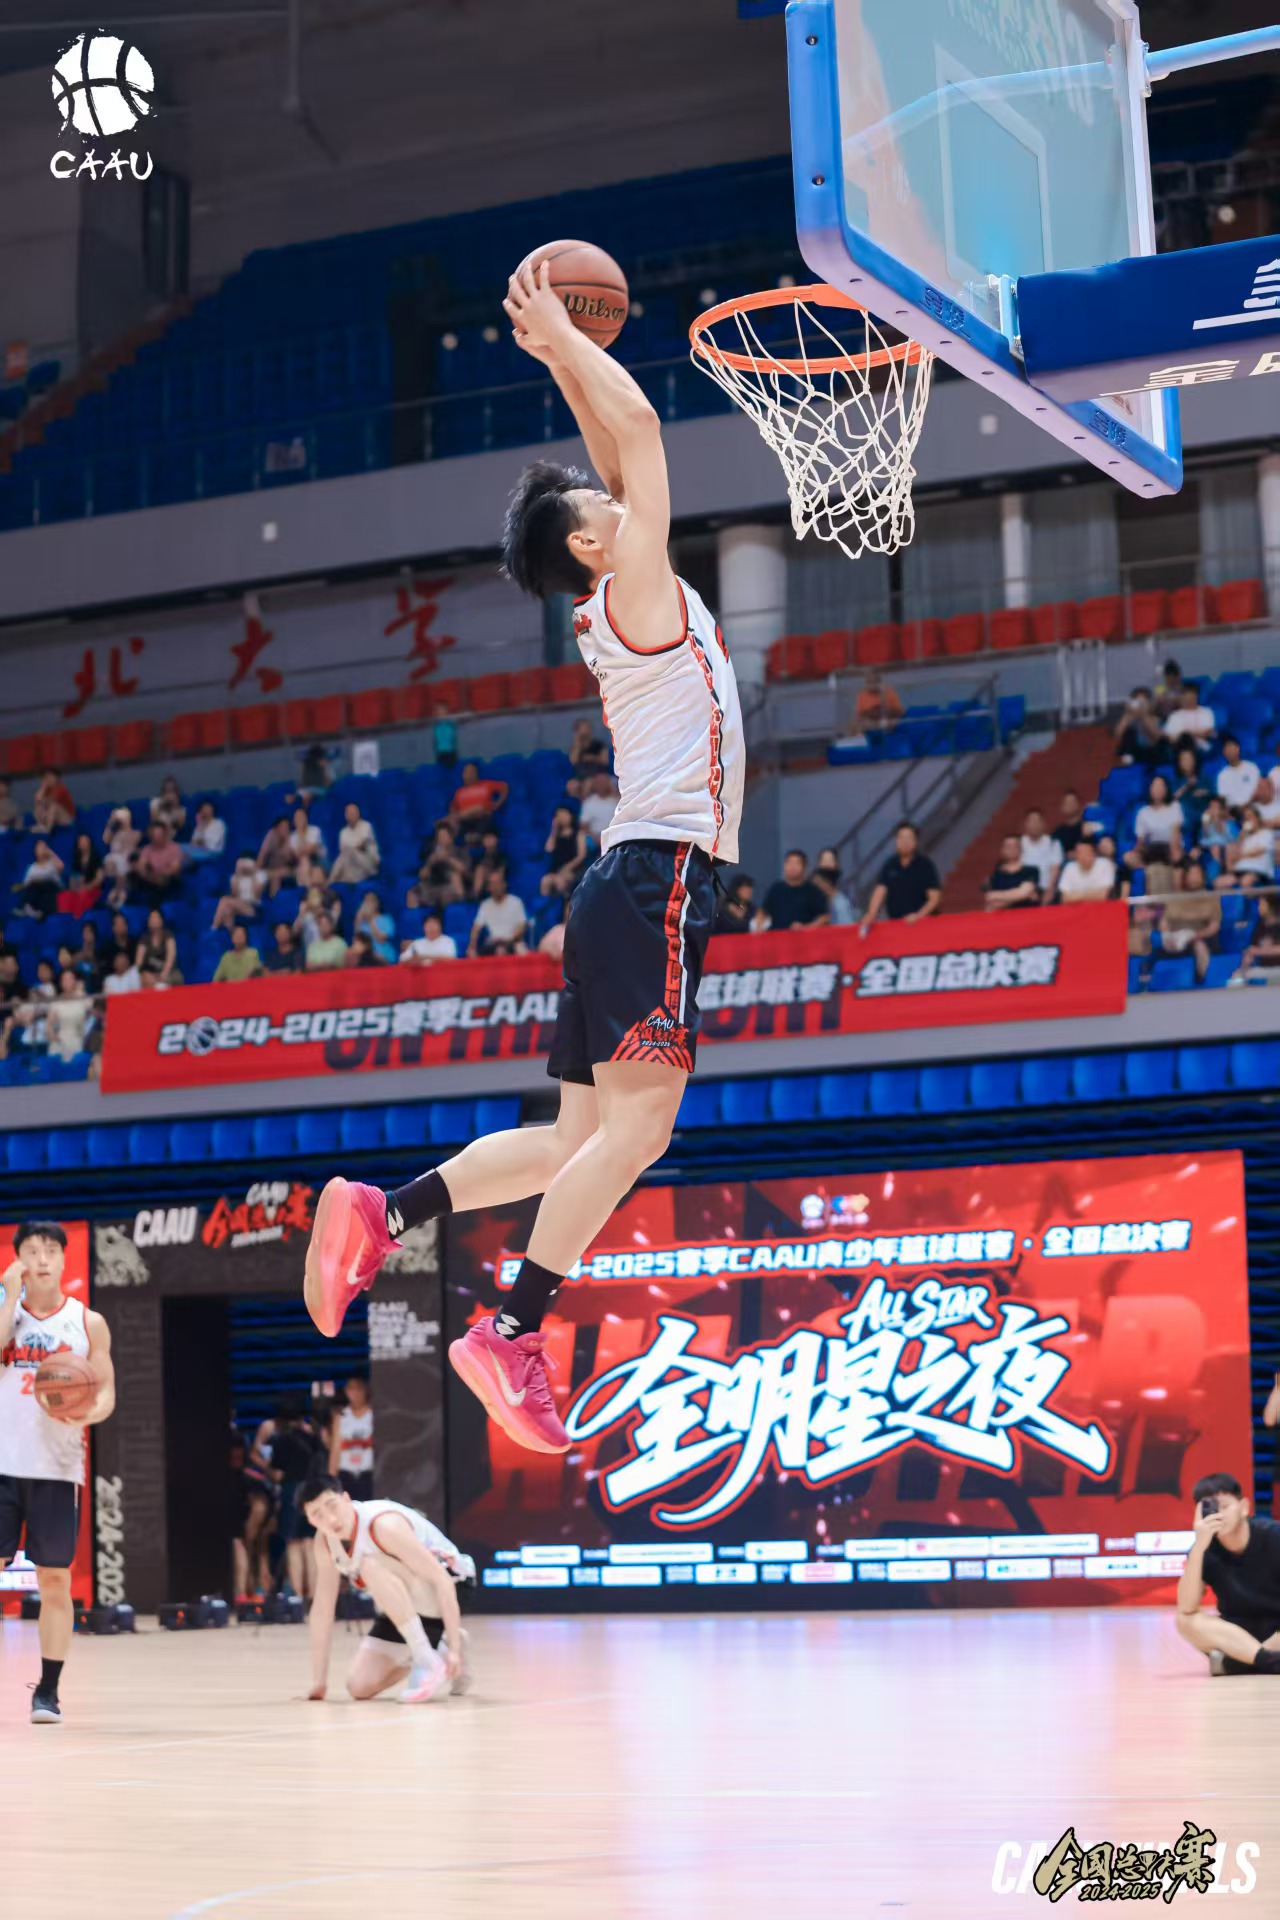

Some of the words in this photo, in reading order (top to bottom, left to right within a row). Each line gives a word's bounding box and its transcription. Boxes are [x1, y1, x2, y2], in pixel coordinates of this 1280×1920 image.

[563, 293, 626, 321] Wilson
[646, 1015, 674, 1031] CAAU
[134, 1206, 198, 1248] CAAU
[565, 1302, 1111, 1524] 全明星之夜
